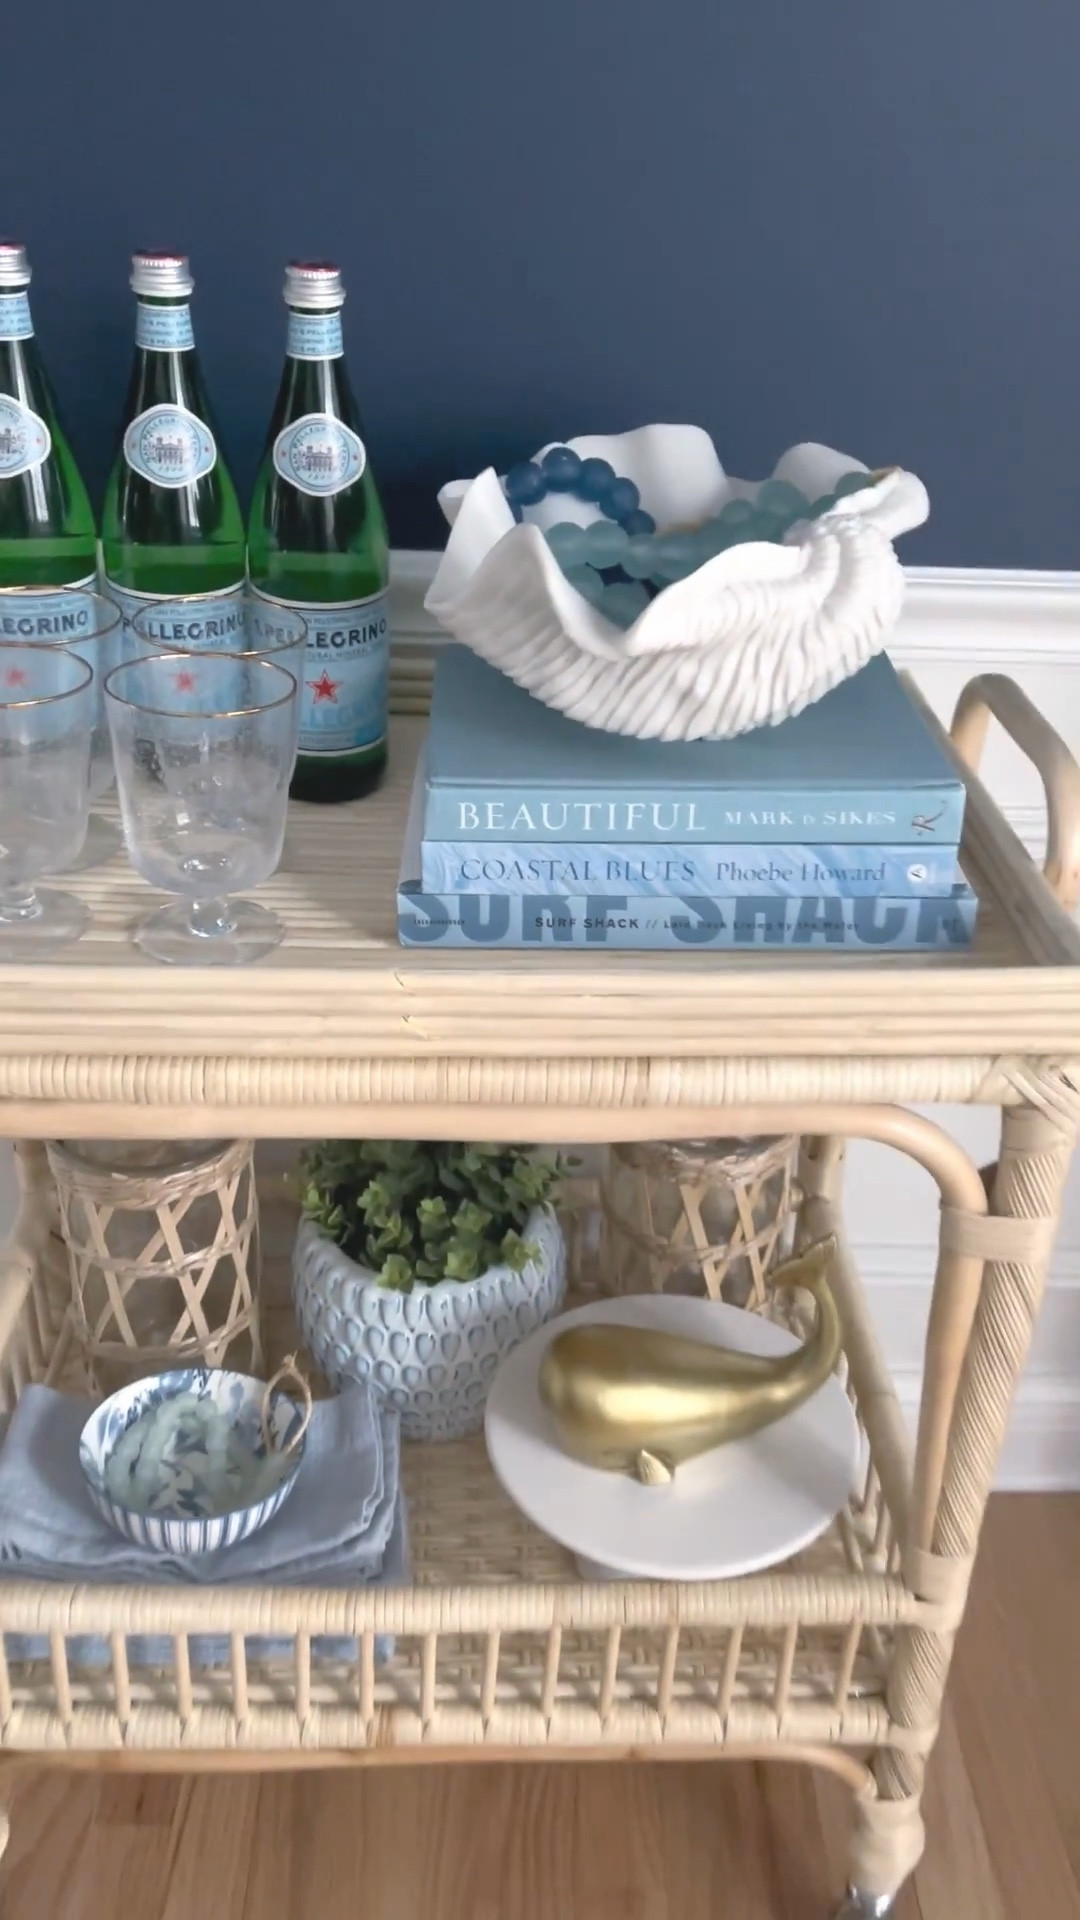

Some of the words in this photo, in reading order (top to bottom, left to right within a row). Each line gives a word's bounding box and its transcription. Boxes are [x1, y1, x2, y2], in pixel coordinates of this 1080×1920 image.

[0, 609, 89, 635] EGRINO
[457, 802, 706, 831] BEAUTIFUL
[724, 811, 793, 825] MARK
[822, 811, 897, 825] SIKES
[460, 859, 597, 881] COASTAL
[606, 860, 695, 882] BLUES
[716, 862, 793, 882] Phoebe
[802, 862, 886, 882] Howard
[397, 894, 628, 942] SURF
[534, 917, 578, 929] SURF
[583, 918, 640, 929] SHACK
